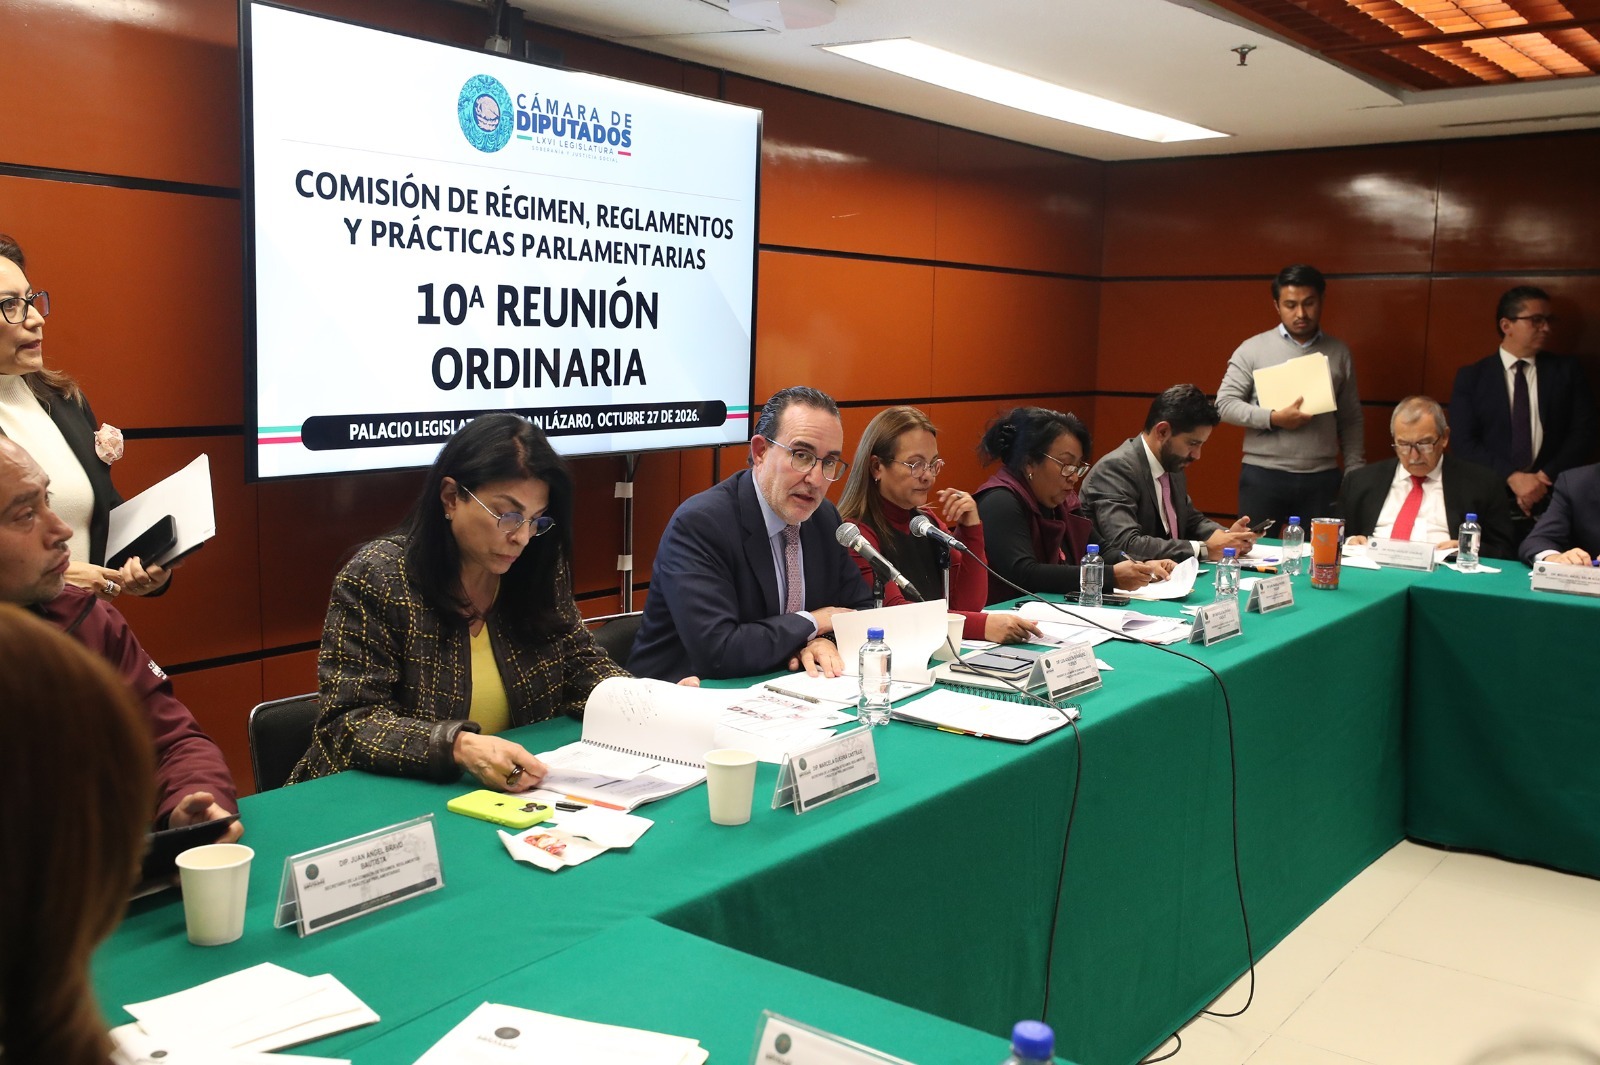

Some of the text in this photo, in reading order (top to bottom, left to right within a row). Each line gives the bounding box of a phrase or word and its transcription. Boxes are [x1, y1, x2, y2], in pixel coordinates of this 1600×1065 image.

[516, 93, 632, 129] CÁMARA DE
[516, 110, 632, 148] DIPUTADOS
[536, 137, 614, 155] LXVI LEGISLATURA
[571, 152, 598, 160] JUSTICIA
[295, 169, 734, 240] COMISIÓN DE RÉGIMEN, REGLAMENTOS
[344, 214, 706, 271] Y PRÁCTICAS PARLAMENTARIAS
[497, 276, 659, 330] REUNIÓN
[432, 347, 647, 391] ORDINARIA
[349, 420, 413, 441] PALACIO
[546, 410, 594, 429] LÁZARO,
[597, 409, 647, 427] OCTUBRE
[646, 410, 659, 424] 27
[661, 409, 674, 424] DE
[674, 408, 700, 423] 2026.
[350, 853, 365, 864] JUAN
